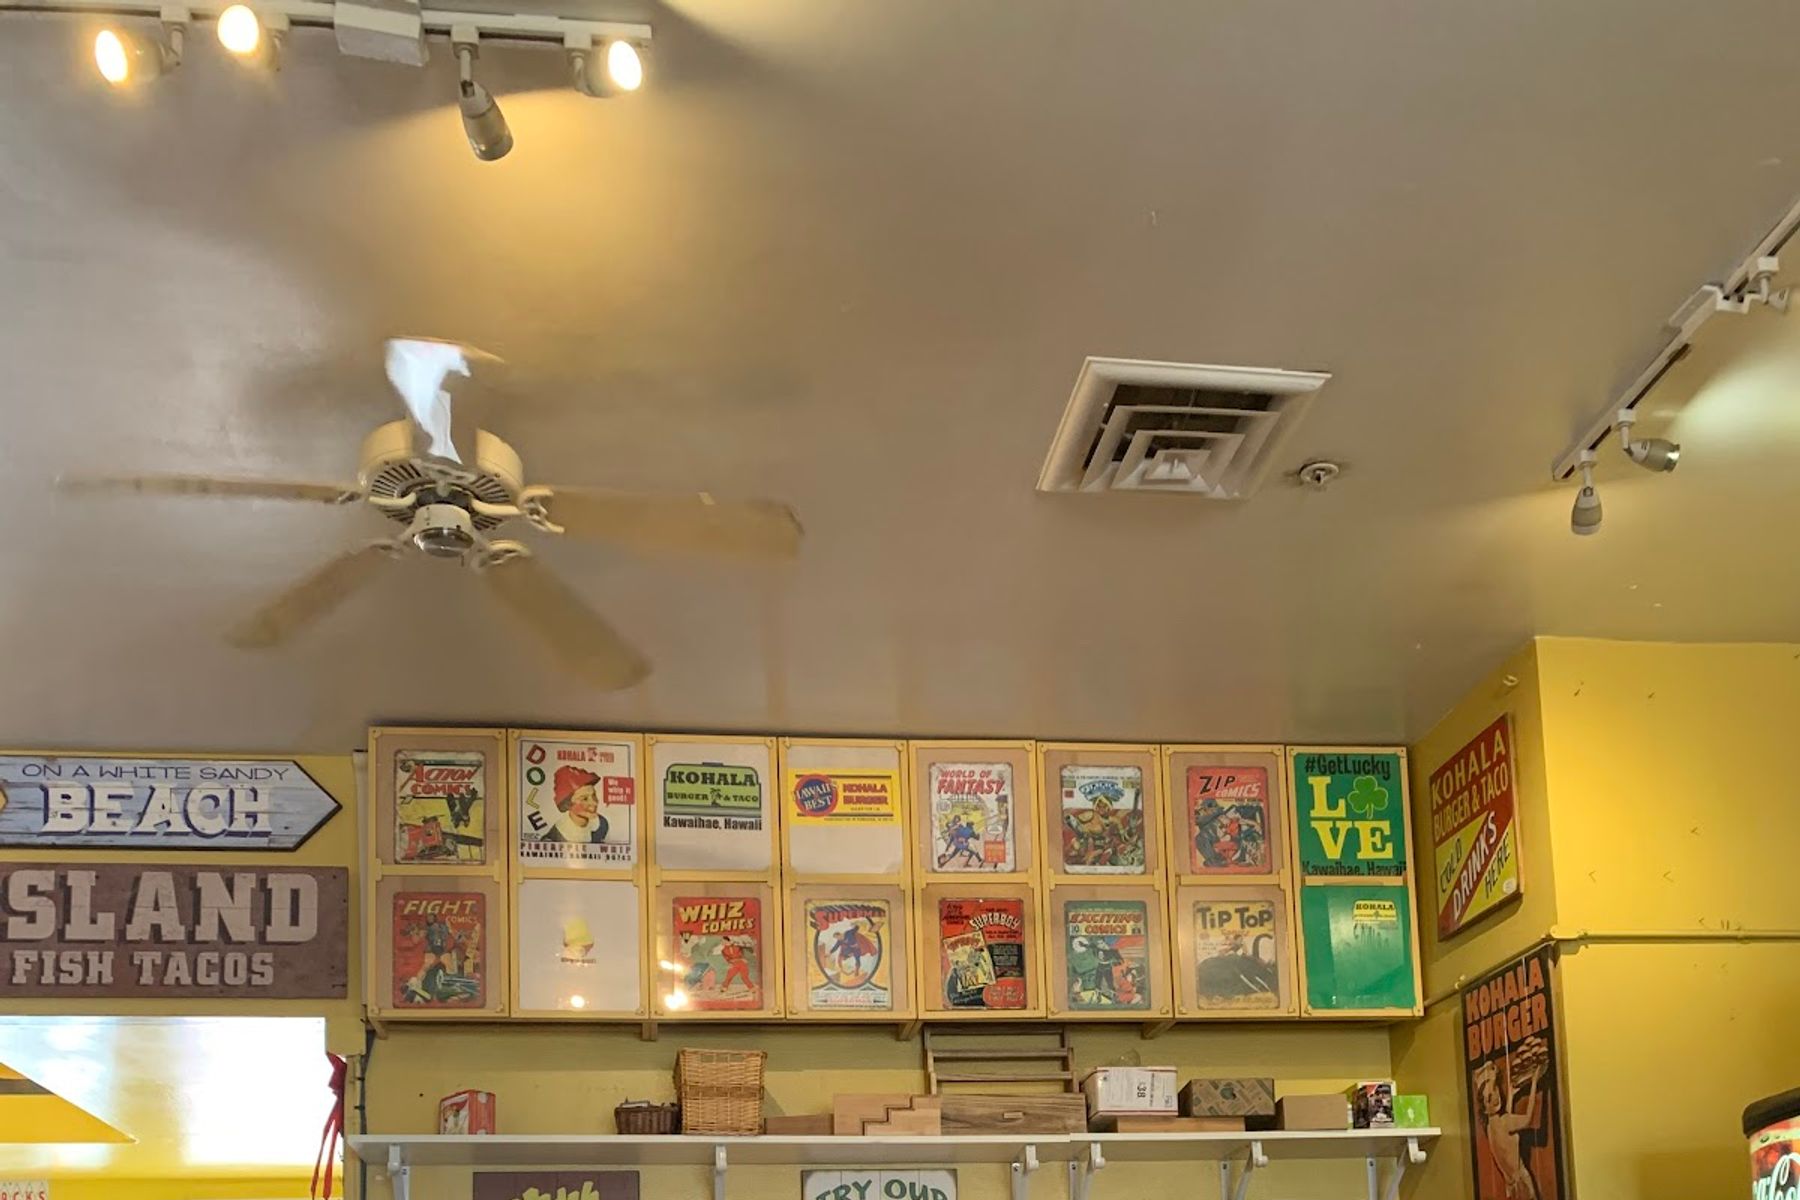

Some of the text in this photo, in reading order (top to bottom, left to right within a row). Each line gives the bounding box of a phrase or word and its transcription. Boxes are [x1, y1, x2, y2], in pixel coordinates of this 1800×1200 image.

[22, 764, 289, 781] ON A WHITE SANDY
[670, 770, 756, 787] KOHALA
[1305, 754, 1391, 780] #GetLucky
[1432, 729, 1506, 810] KOHALA
[937, 779, 1006, 795] FANTASY
[1199, 775, 1236, 795] ZIP
[1215, 782, 1261, 798] COMICS
[37, 781, 272, 838] BEACH
[667, 792, 709, 802] BURGER
[733, 795, 759, 803] TACO
[1433, 762, 1509, 843] BURGER & TACO
[664, 816, 762, 831] Kawaihae, Hawaii
[1440, 837, 1463, 894] COLD
[1453, 811, 1498, 922] DRINKS
[1485, 832, 1510, 899] HERE
[403, 899, 477, 915] FIGHT
[679, 901, 745, 923] WHIZ
[702, 918, 754, 933] COMICS
[12, 951, 274, 985] FISH TACOS
[1465, 956, 1545, 1025] KOHALA
[1467, 991, 1549, 1061] BURGER
